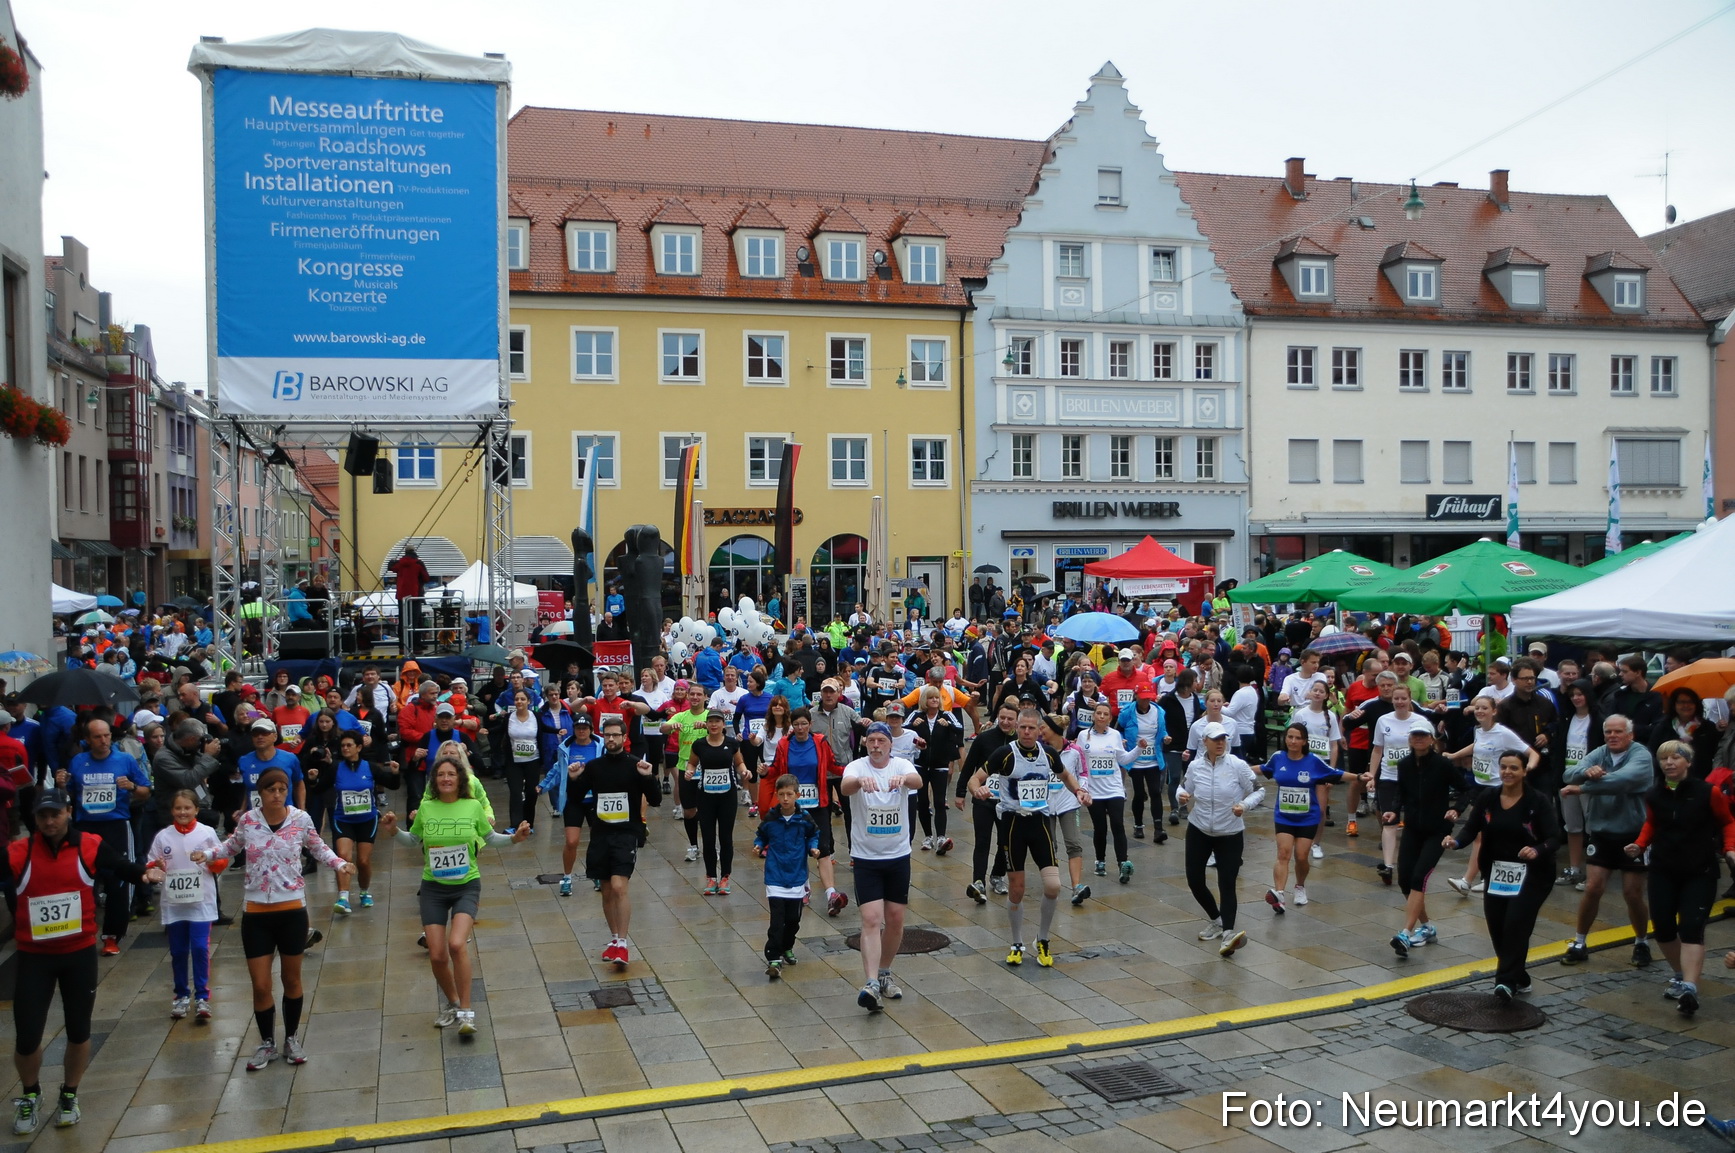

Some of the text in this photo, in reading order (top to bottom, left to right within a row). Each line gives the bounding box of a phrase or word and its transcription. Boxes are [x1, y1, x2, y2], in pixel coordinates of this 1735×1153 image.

[269, 95, 444, 123] Messeauftritte
[244, 117, 465, 140] Hauptversammlungen Get together
[272, 137, 426, 157] Tagungen Roadshows
[263, 153, 451, 178] Sportveranstaltungen
[245, 171, 470, 195] Installationen TV-Produktionen
[262, 195, 404, 211] Kulturveranstaltungen
[286, 211, 452, 224] Fashionshows Produktpräsentationen
[271, 222, 440, 244] Firmeneröffnungen
[298, 258, 404, 280] Kongresse
[354, 279, 398, 290] Musicals
[308, 288, 387, 304] Konzerte
[329, 303, 377, 313] Tourservice
[293, 332, 426, 346] www.barowski-ag.de
[310, 376, 414, 392] BAROWSKI
[420, 376, 449, 392] AG
[310, 393, 371, 402] Veranstaltungs-
[389, 393, 447, 402] Mediensysteme
[1066, 398, 1173, 414] BRILLEN WEBER
[1052, 501, 1182, 519] BRILLEN WEBER
[516, 744, 535, 752] 5030
[1091, 760, 1113, 769] 2839
[706, 775, 728, 785] 2229
[86, 791, 113, 803] 2768
[345, 795, 369, 805] 5173
[1022, 788, 1046, 800] 2132
[1282, 793, 1307, 804] 5074
[603, 800, 623, 811] 576
[870, 813, 899, 826] 3180
[434, 852, 466, 869] 2412
[169, 876, 200, 890] 4024
[1494, 869, 1522, 883] 2264
[40, 903, 71, 922] 337
[44, 923, 69, 932] Konrad
